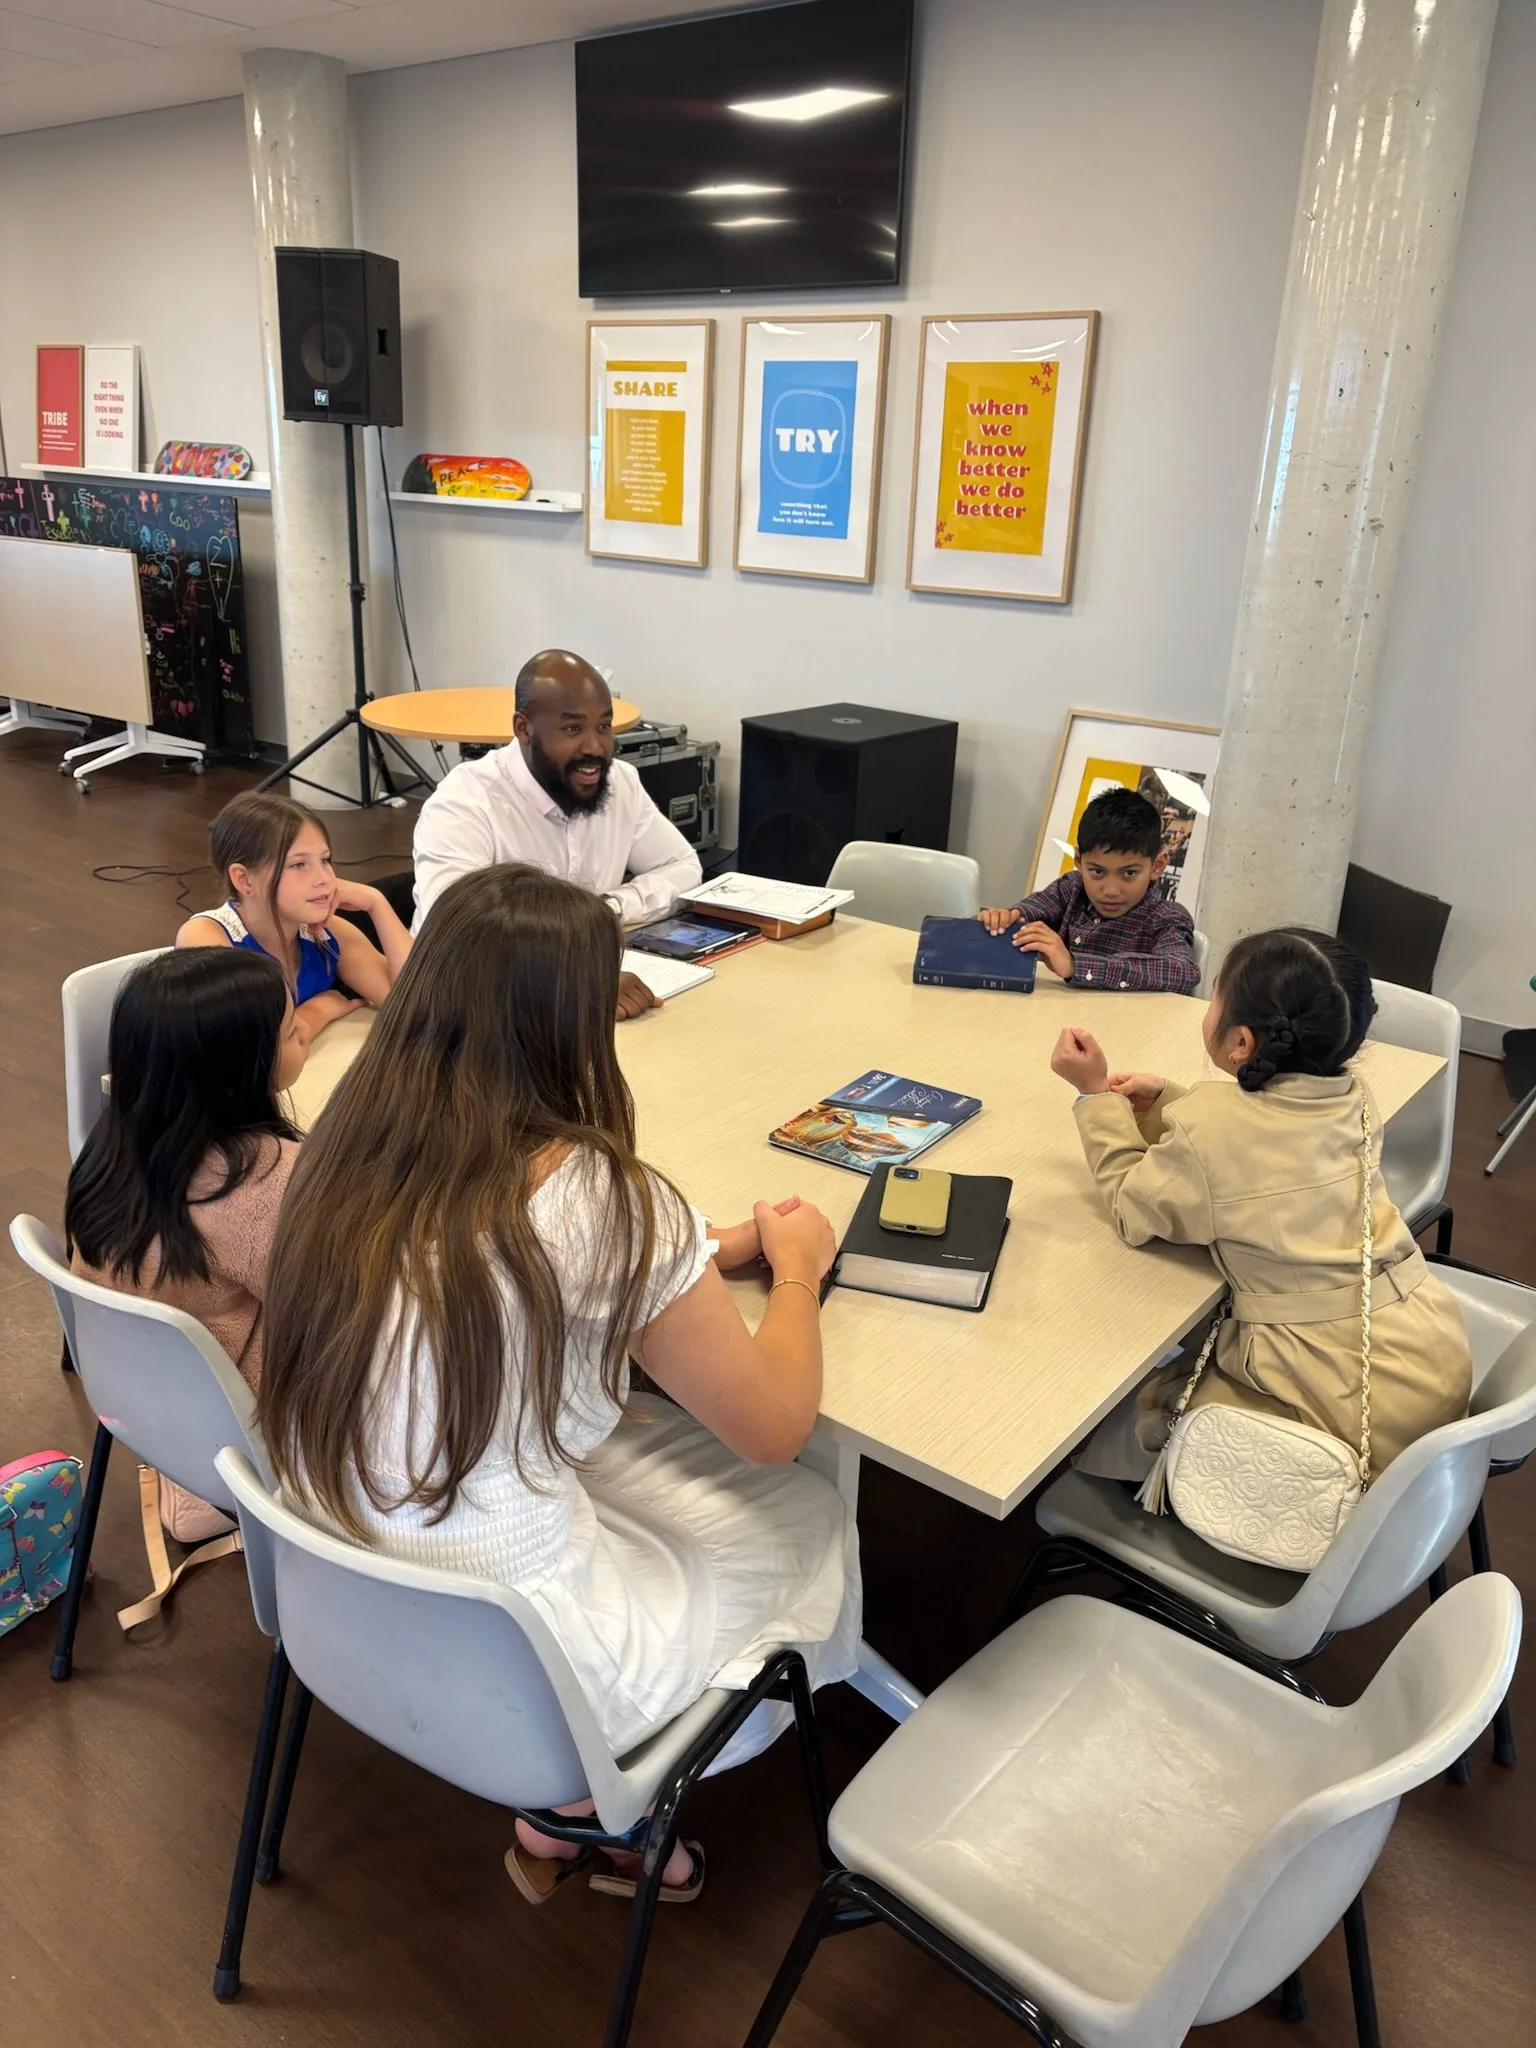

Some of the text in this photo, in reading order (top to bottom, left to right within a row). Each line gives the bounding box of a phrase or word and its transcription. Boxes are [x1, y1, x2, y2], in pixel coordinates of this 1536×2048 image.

[613, 380, 678, 397] SHARE
[967, 399, 1028, 416] when
[42, 411, 68, 426] TRIBE
[980, 423, 1012, 437] we
[776, 428, 839, 454] TRY
[964, 440, 1026, 457] know
[172, 446, 221, 477] LOVE
[959, 459, 1030, 478] better
[440, 459, 486, 488] PEACE
[959, 481, 1025, 498] we do
[955, 499, 1026, 518] better
